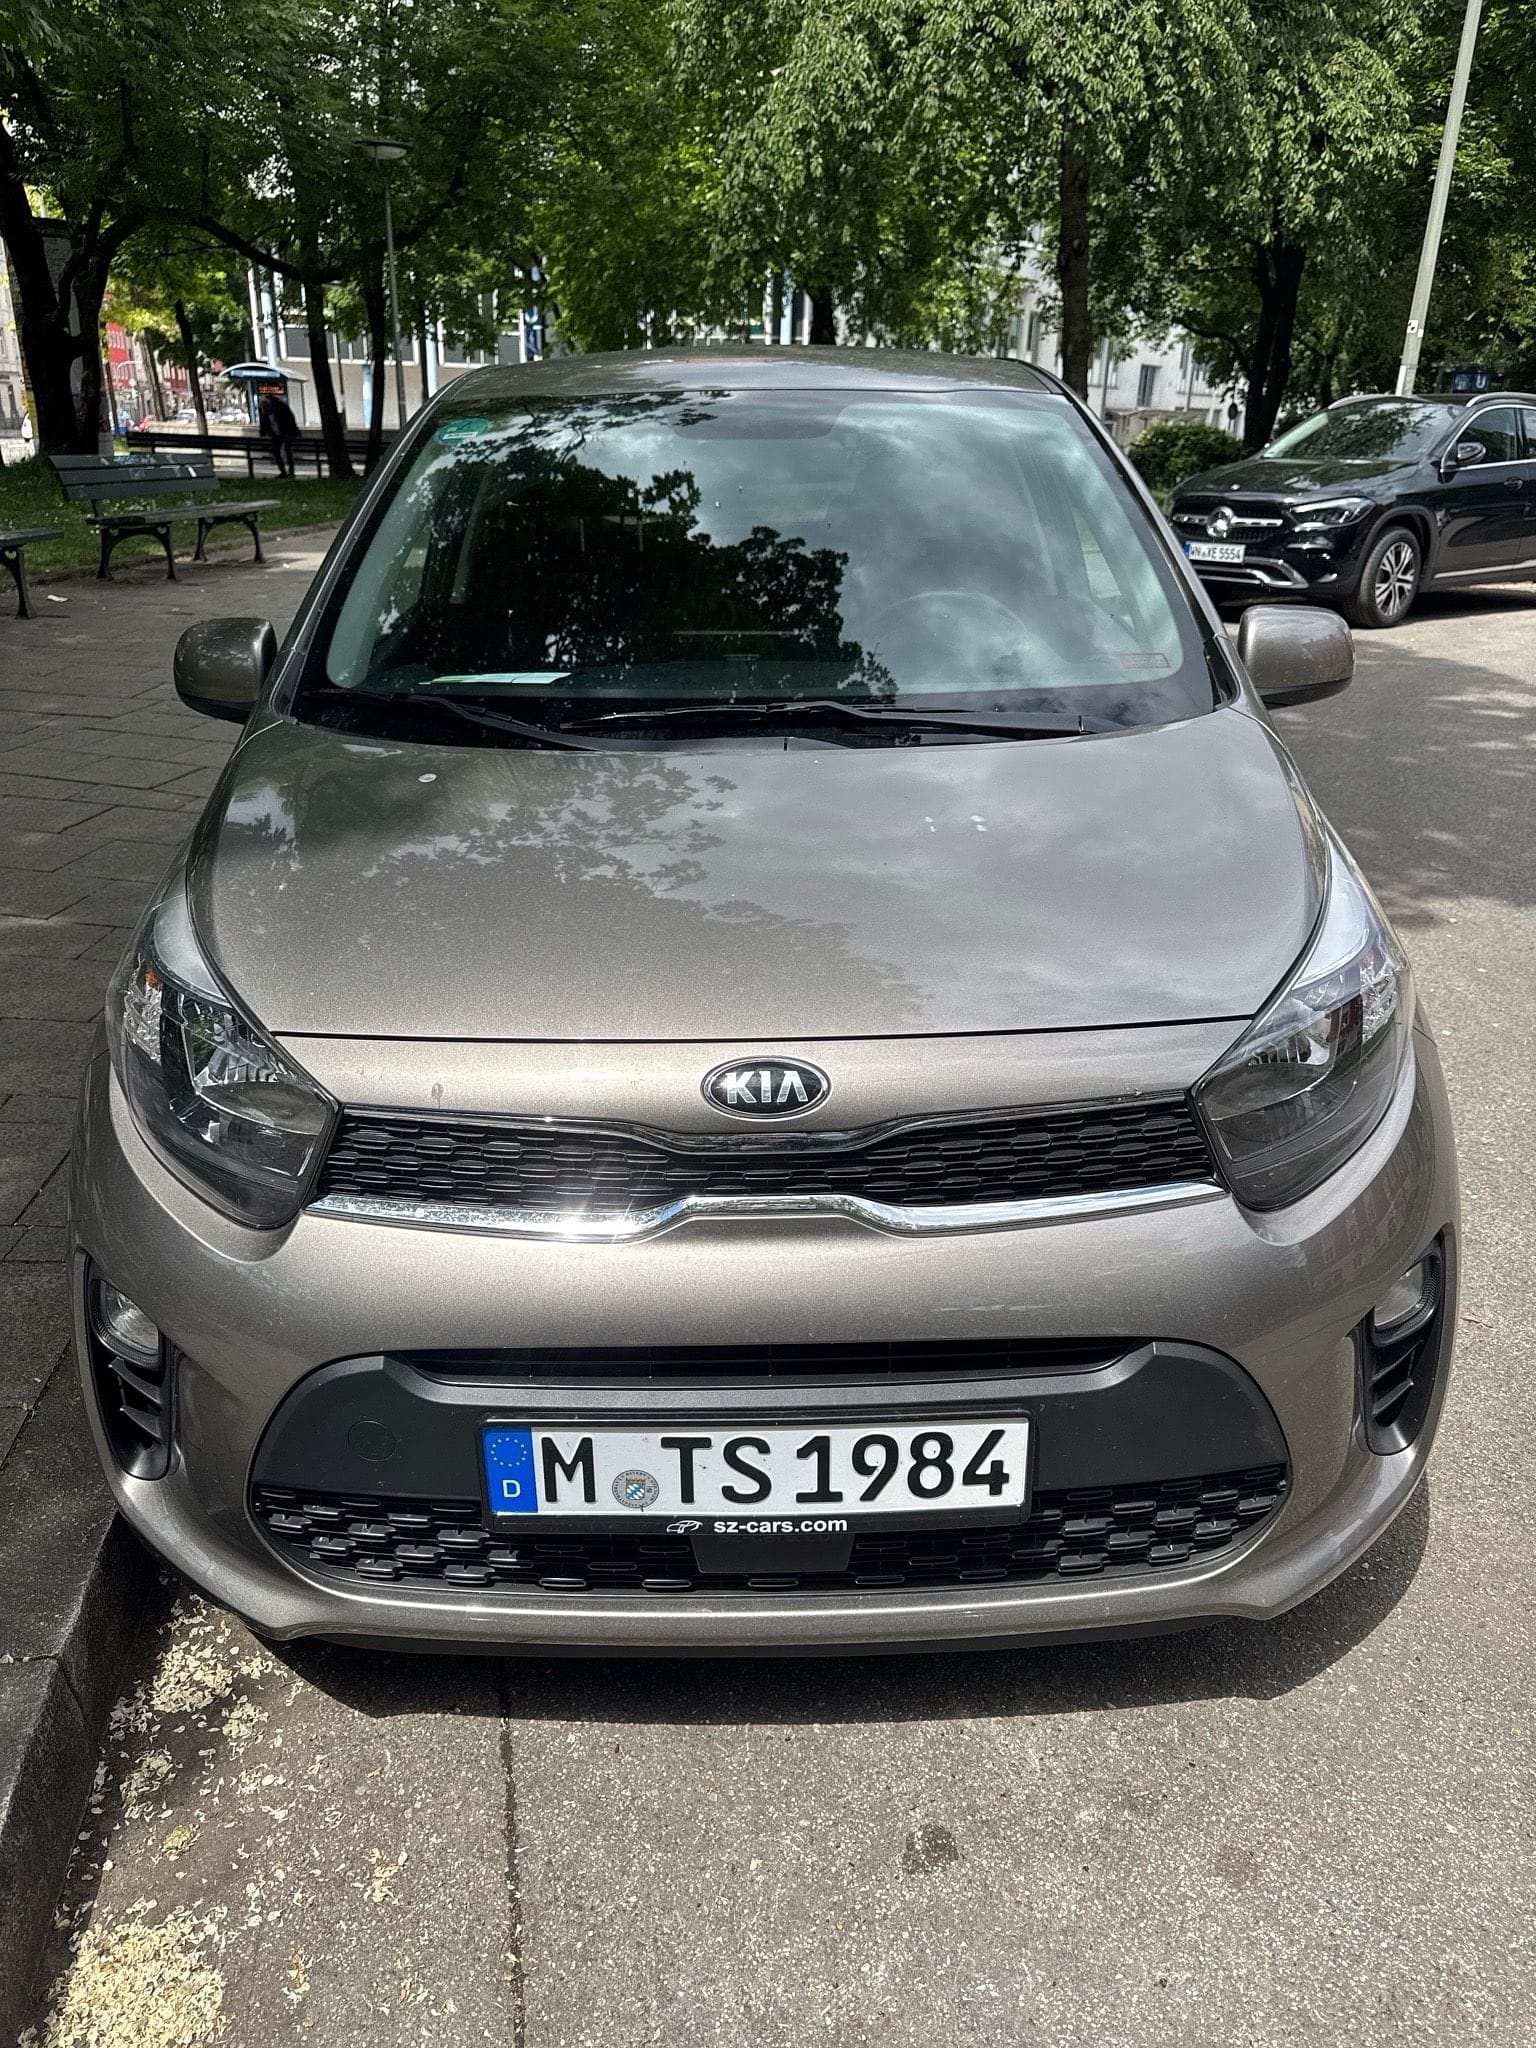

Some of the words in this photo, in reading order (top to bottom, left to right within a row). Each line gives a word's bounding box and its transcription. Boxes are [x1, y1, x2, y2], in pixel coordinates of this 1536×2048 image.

[1475, 375, 1486, 388] U
[726, 1070, 808, 1104] KIA
[541, 1436, 598, 1504] M
[502, 1479, 522, 1499] D
[713, 1516, 849, 1535] sz-cars.com
